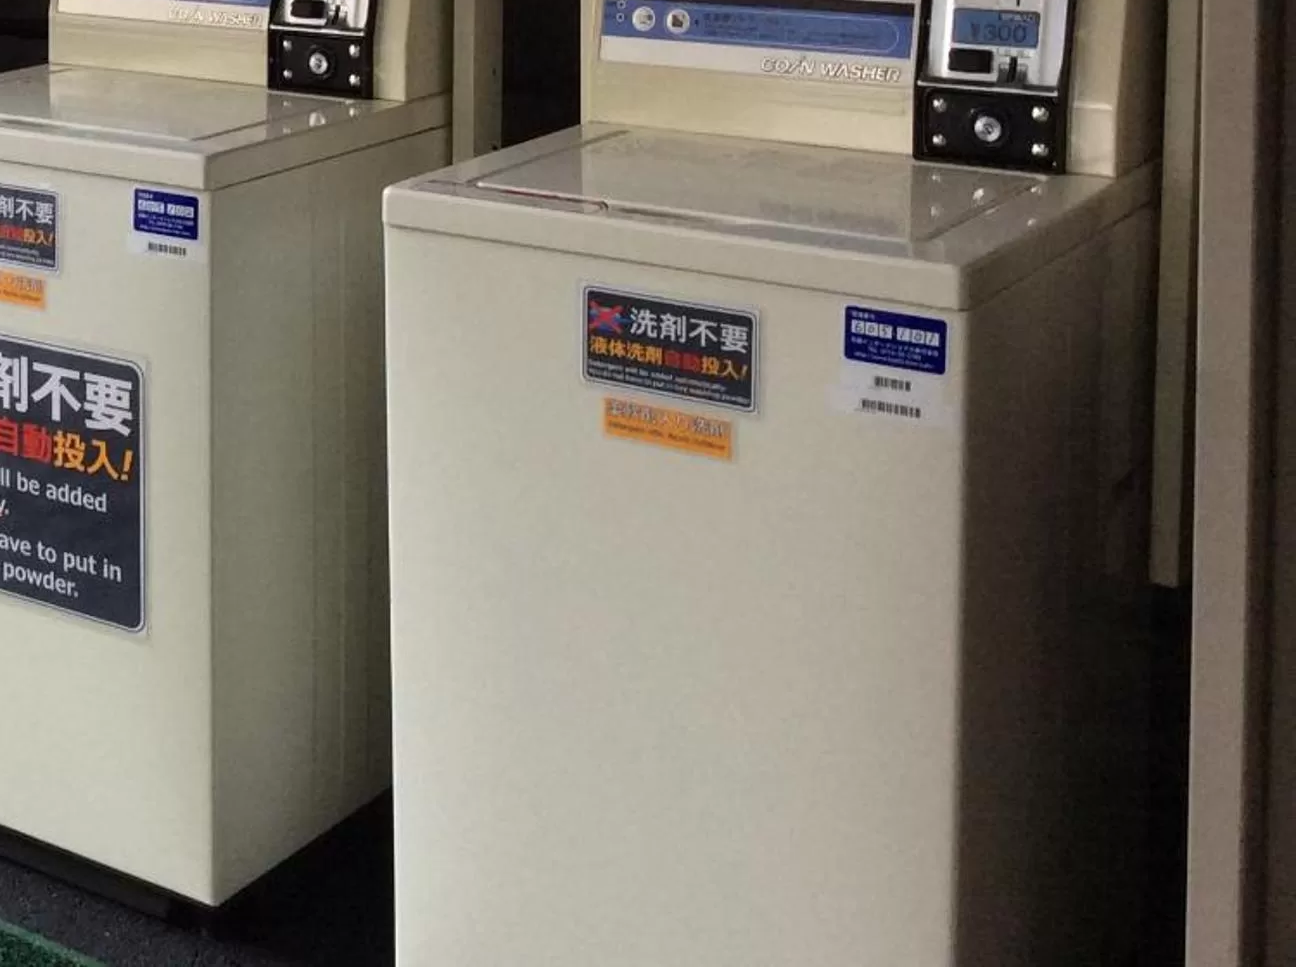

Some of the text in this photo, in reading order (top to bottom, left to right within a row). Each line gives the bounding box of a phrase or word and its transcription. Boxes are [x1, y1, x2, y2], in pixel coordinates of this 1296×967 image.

[819, 62, 900, 81] WASHER
[630, 307, 749, 354] 洗剤不要
[17, 472, 40, 495] be
[46, 481, 107, 513] added
[4, 561, 79, 598] powder.
[37, 541, 57, 564] to
[63, 550, 97, 576] put
[103, 559, 122, 582] in
